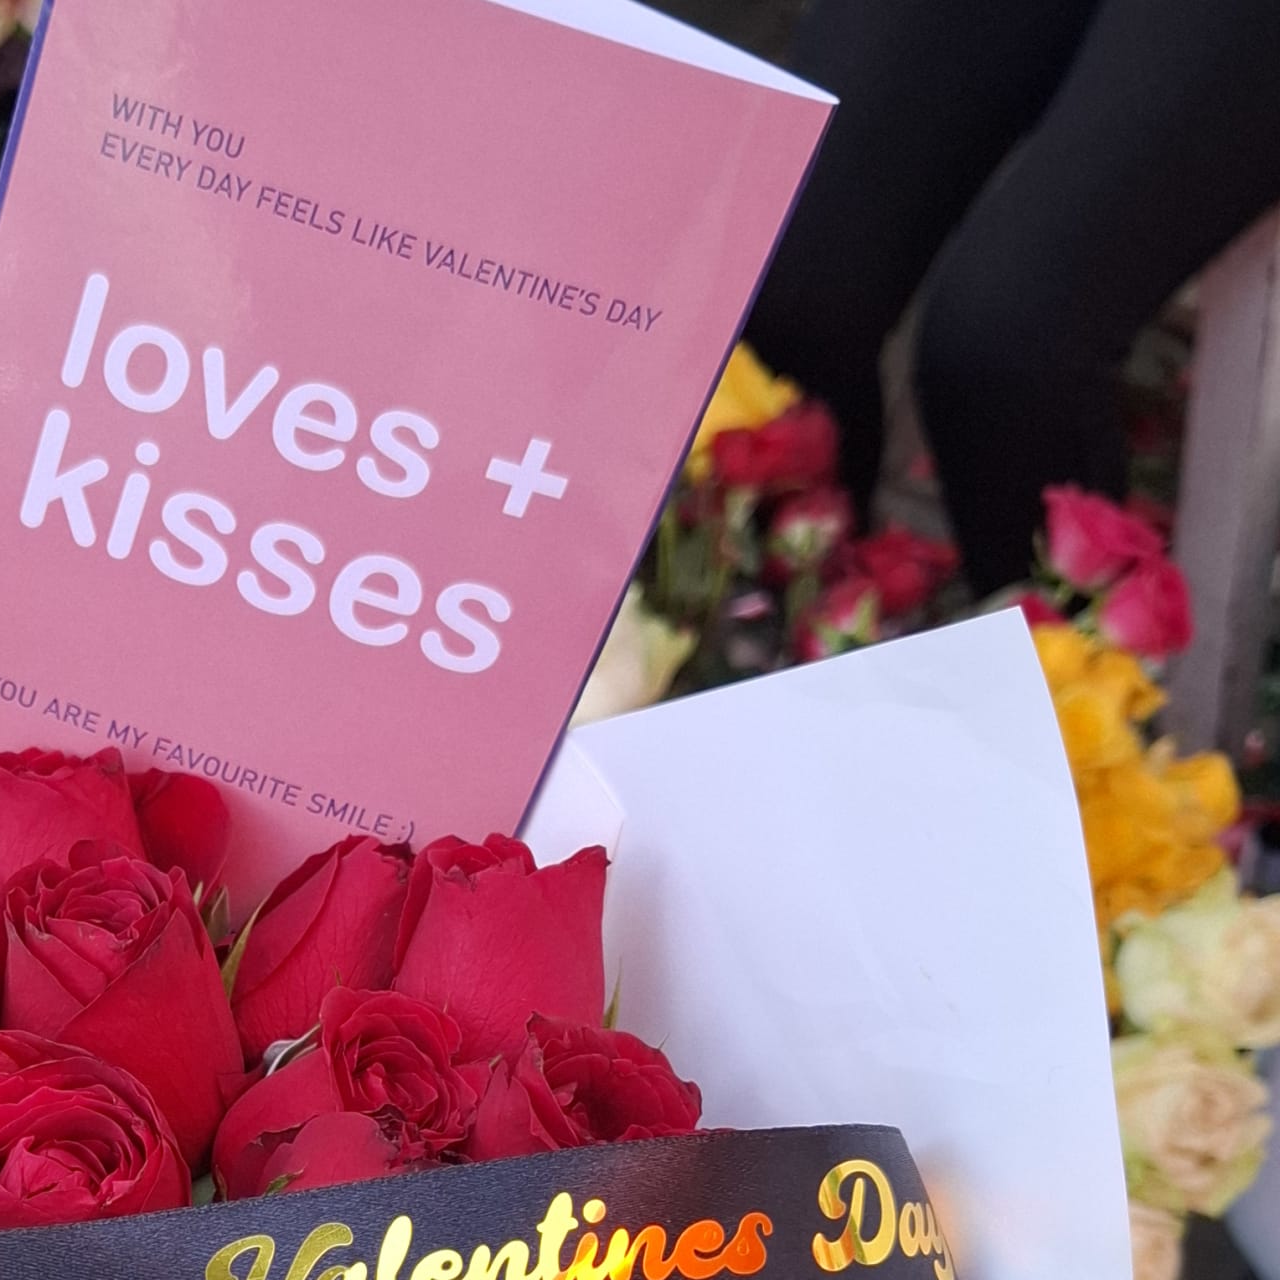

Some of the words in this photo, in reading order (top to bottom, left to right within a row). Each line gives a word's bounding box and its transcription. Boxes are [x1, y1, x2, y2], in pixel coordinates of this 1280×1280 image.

[111, 93, 184, 139] WITH
[192, 119, 245, 159] YOU
[100, 132, 193, 181] EVERY
[197, 166, 252, 202] DAY
[256, 186, 345, 235] FEELS
[352, 218, 417, 260] LIKE
[424, 240, 600, 317] VALENTINE'S
[605, 298, 663, 333] DAY
[61, 273, 439, 498] loves
[485, 438, 568, 518] +
[20, 409, 511, 673] kisses
[43, 699, 100, 733] ARE
[107, 719, 149, 749] MY
[153, 738, 302, 806] FAVOURITE
[307, 793, 393, 836] SMILE
